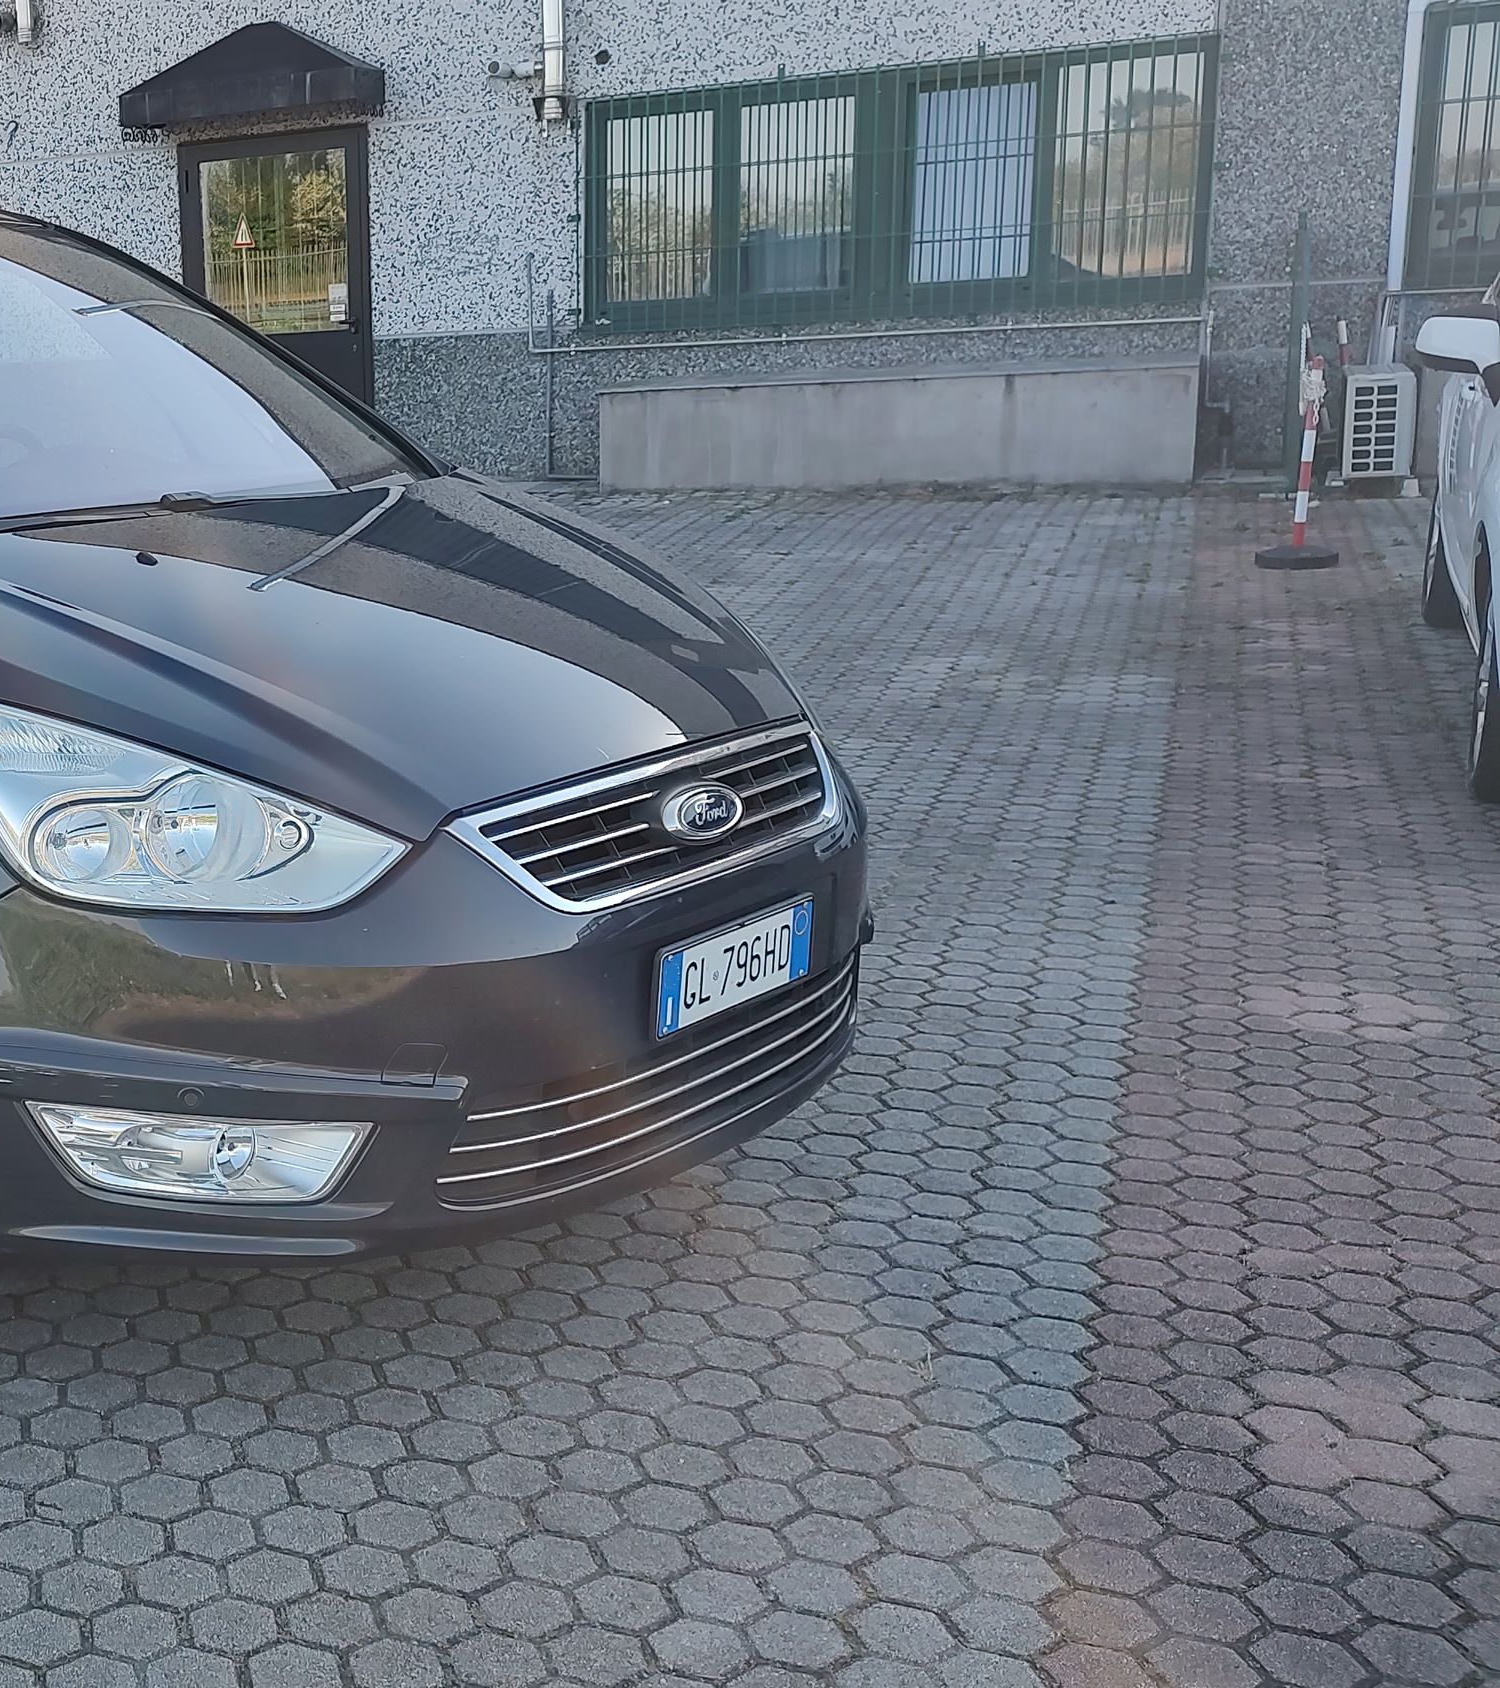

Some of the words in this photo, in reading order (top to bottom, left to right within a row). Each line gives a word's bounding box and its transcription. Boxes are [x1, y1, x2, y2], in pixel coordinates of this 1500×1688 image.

[694, 797, 729, 826] Ford
[683, 957, 711, 1009] GL
[720, 924, 791, 996] 796HD
